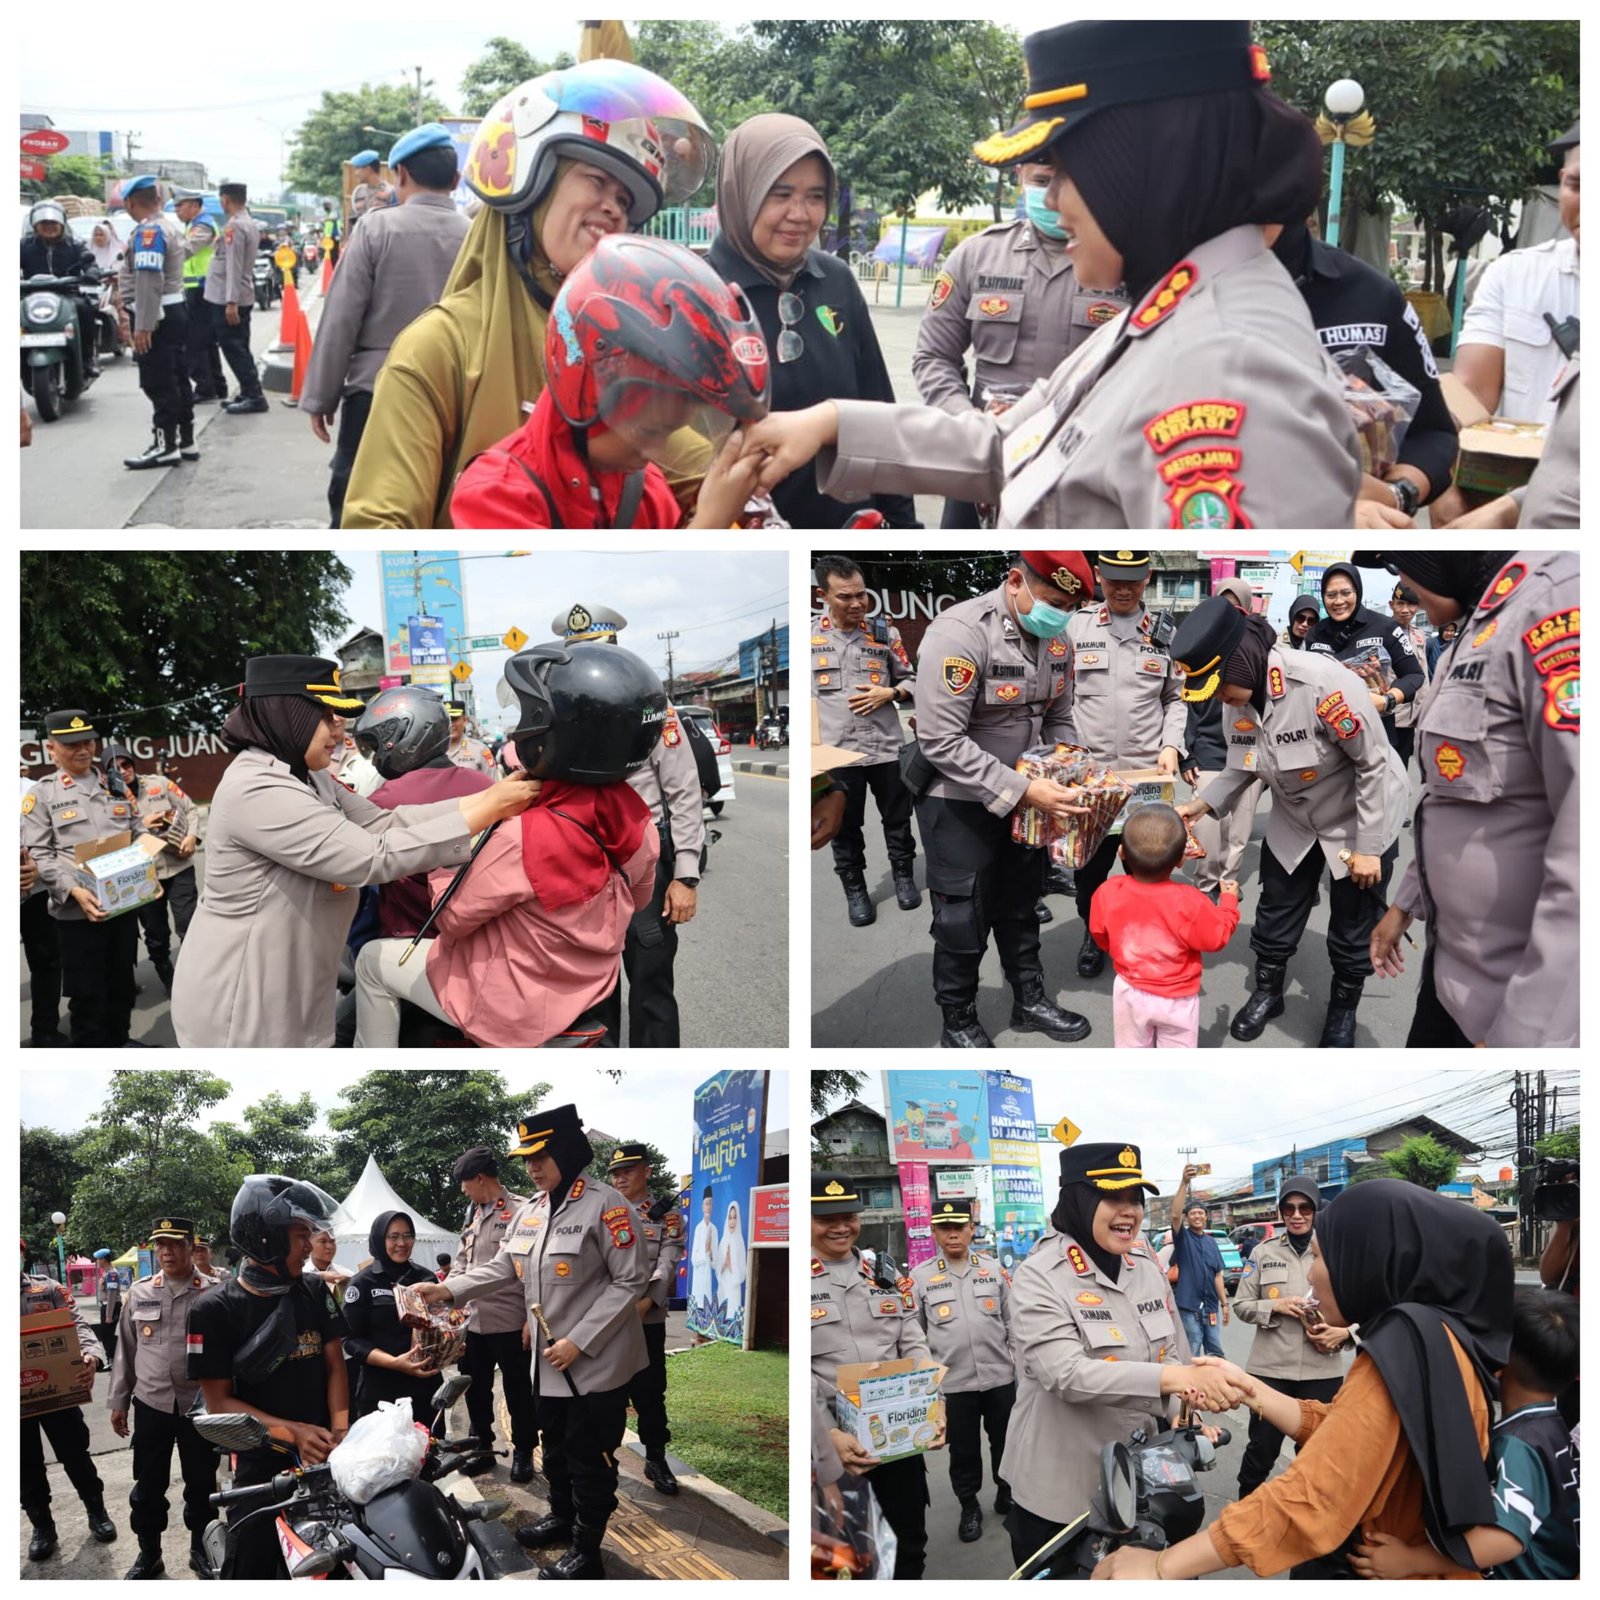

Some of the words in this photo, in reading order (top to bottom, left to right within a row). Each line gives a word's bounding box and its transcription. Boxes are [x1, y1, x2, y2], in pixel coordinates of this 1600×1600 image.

[1325, 327, 1382, 343] HUMAS
[1076, 640, 1107, 650] MAKMURI
[1139, 644, 1167, 656] POLRI
[1275, 728, 1308, 745] POLRI
[991, 1115, 1035, 1130] HATI-HATI
[991, 1126, 1004, 1138] DI
[1005, 1127, 1036, 1142] JALAN
[938, 1173, 957, 1181] KLINIK
[957, 1172, 972, 1181] MATA
[993, 1168, 1040, 1180] KELUARGA
[994, 1180, 1042, 1192] MENANTI
[995, 1191, 1006, 1203] DI
[1008, 1192, 1042, 1204] RUMAH
[555, 1224, 583, 1236] POLRI
[972, 1277, 997, 1285] POLRI
[1136, 1297, 1165, 1315] POLRI
[887, 1406, 927, 1424] Floridina
